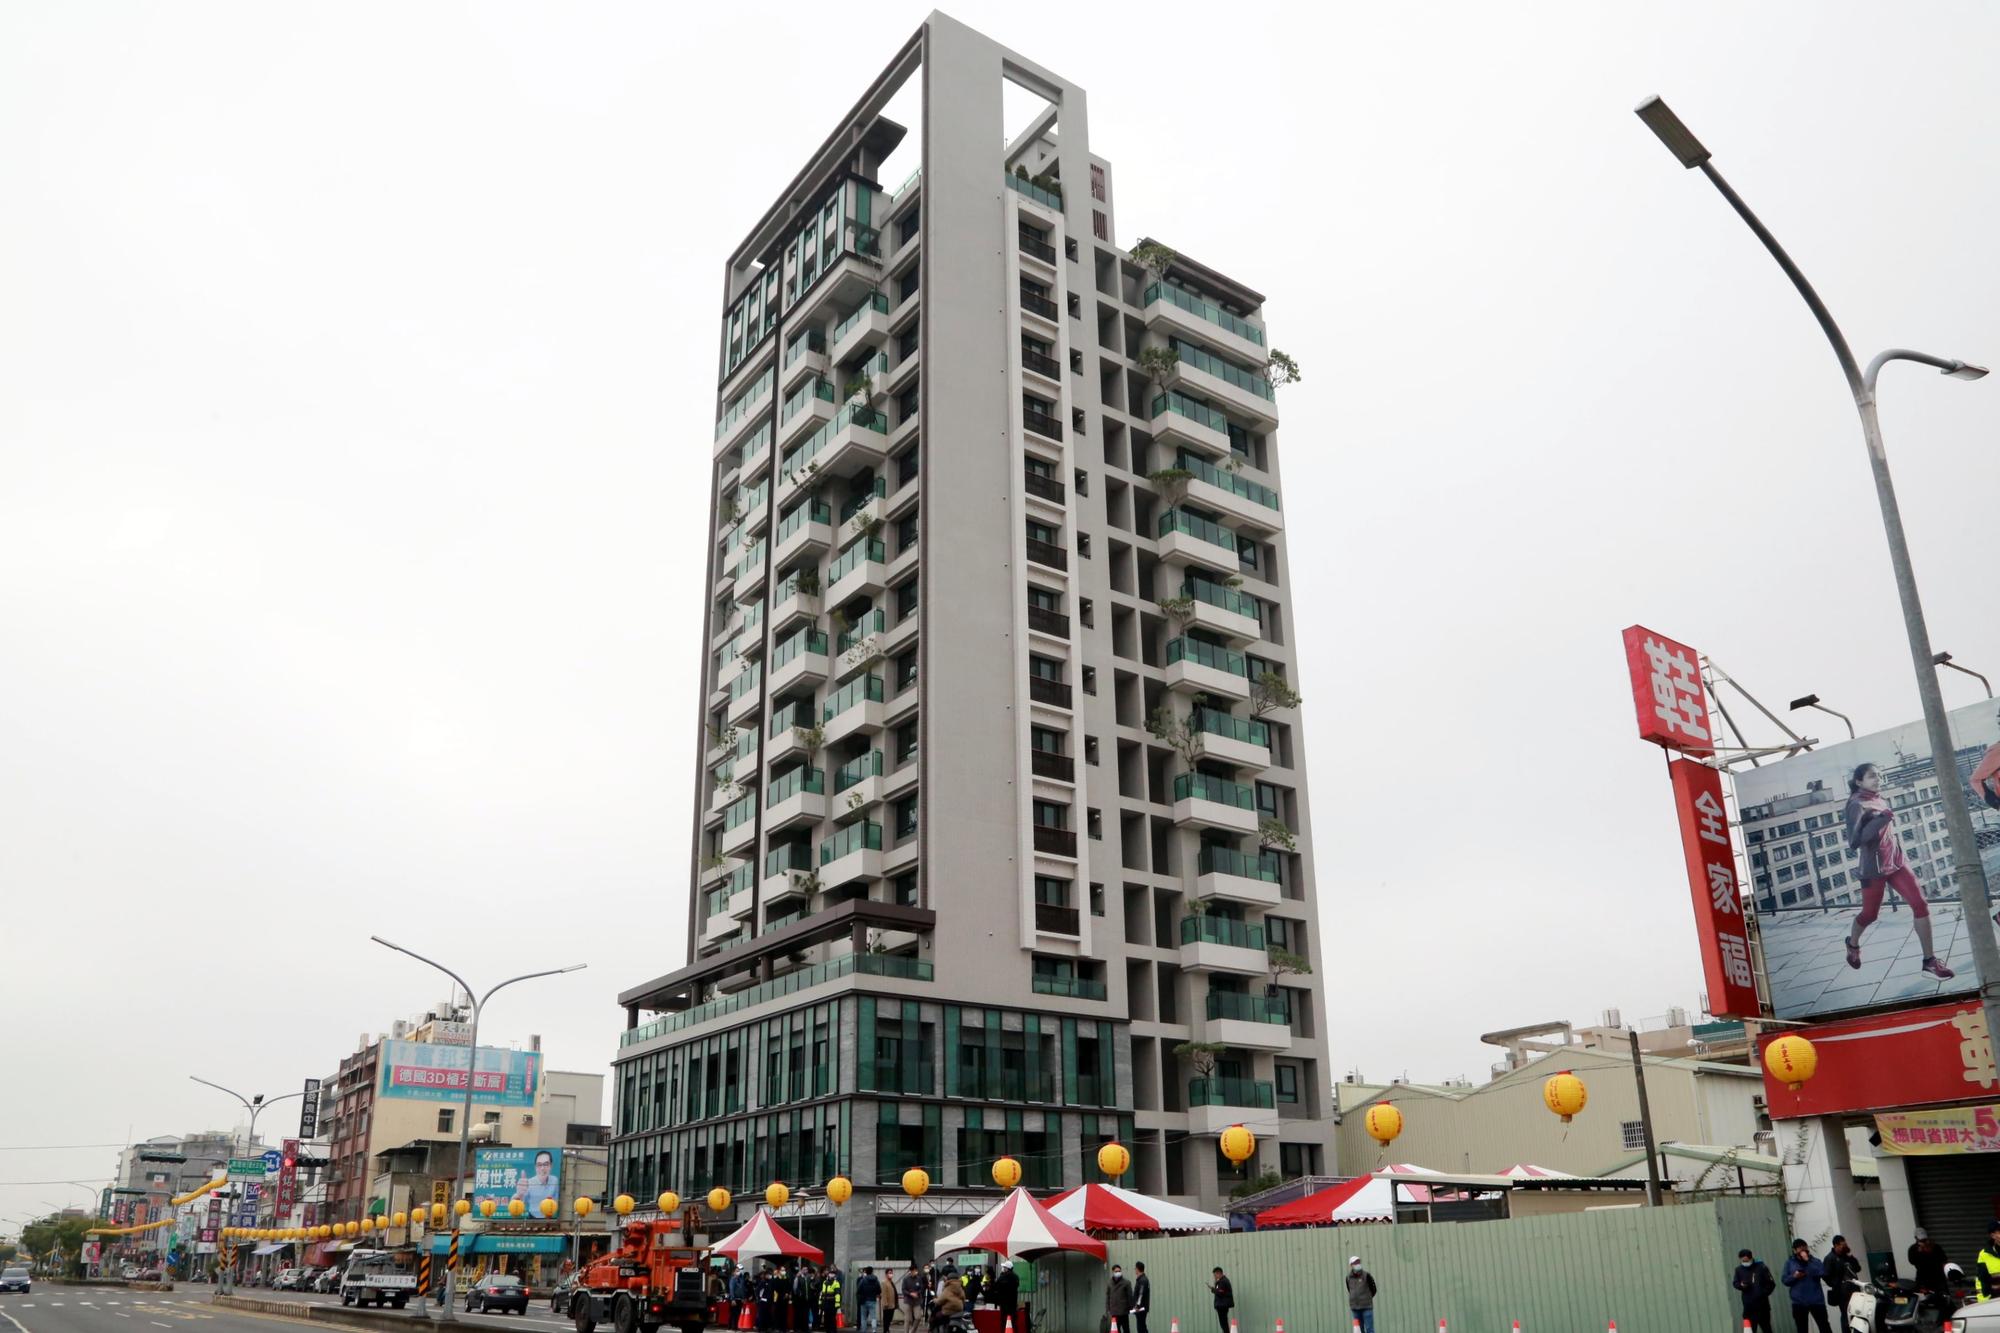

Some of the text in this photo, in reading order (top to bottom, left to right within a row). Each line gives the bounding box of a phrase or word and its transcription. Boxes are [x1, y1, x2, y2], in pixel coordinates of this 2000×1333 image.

[1643, 636, 1709, 741] 鞋
[1695, 790, 1753, 989] 全家福
[475, 1168, 518, 1189] 陳世霖
